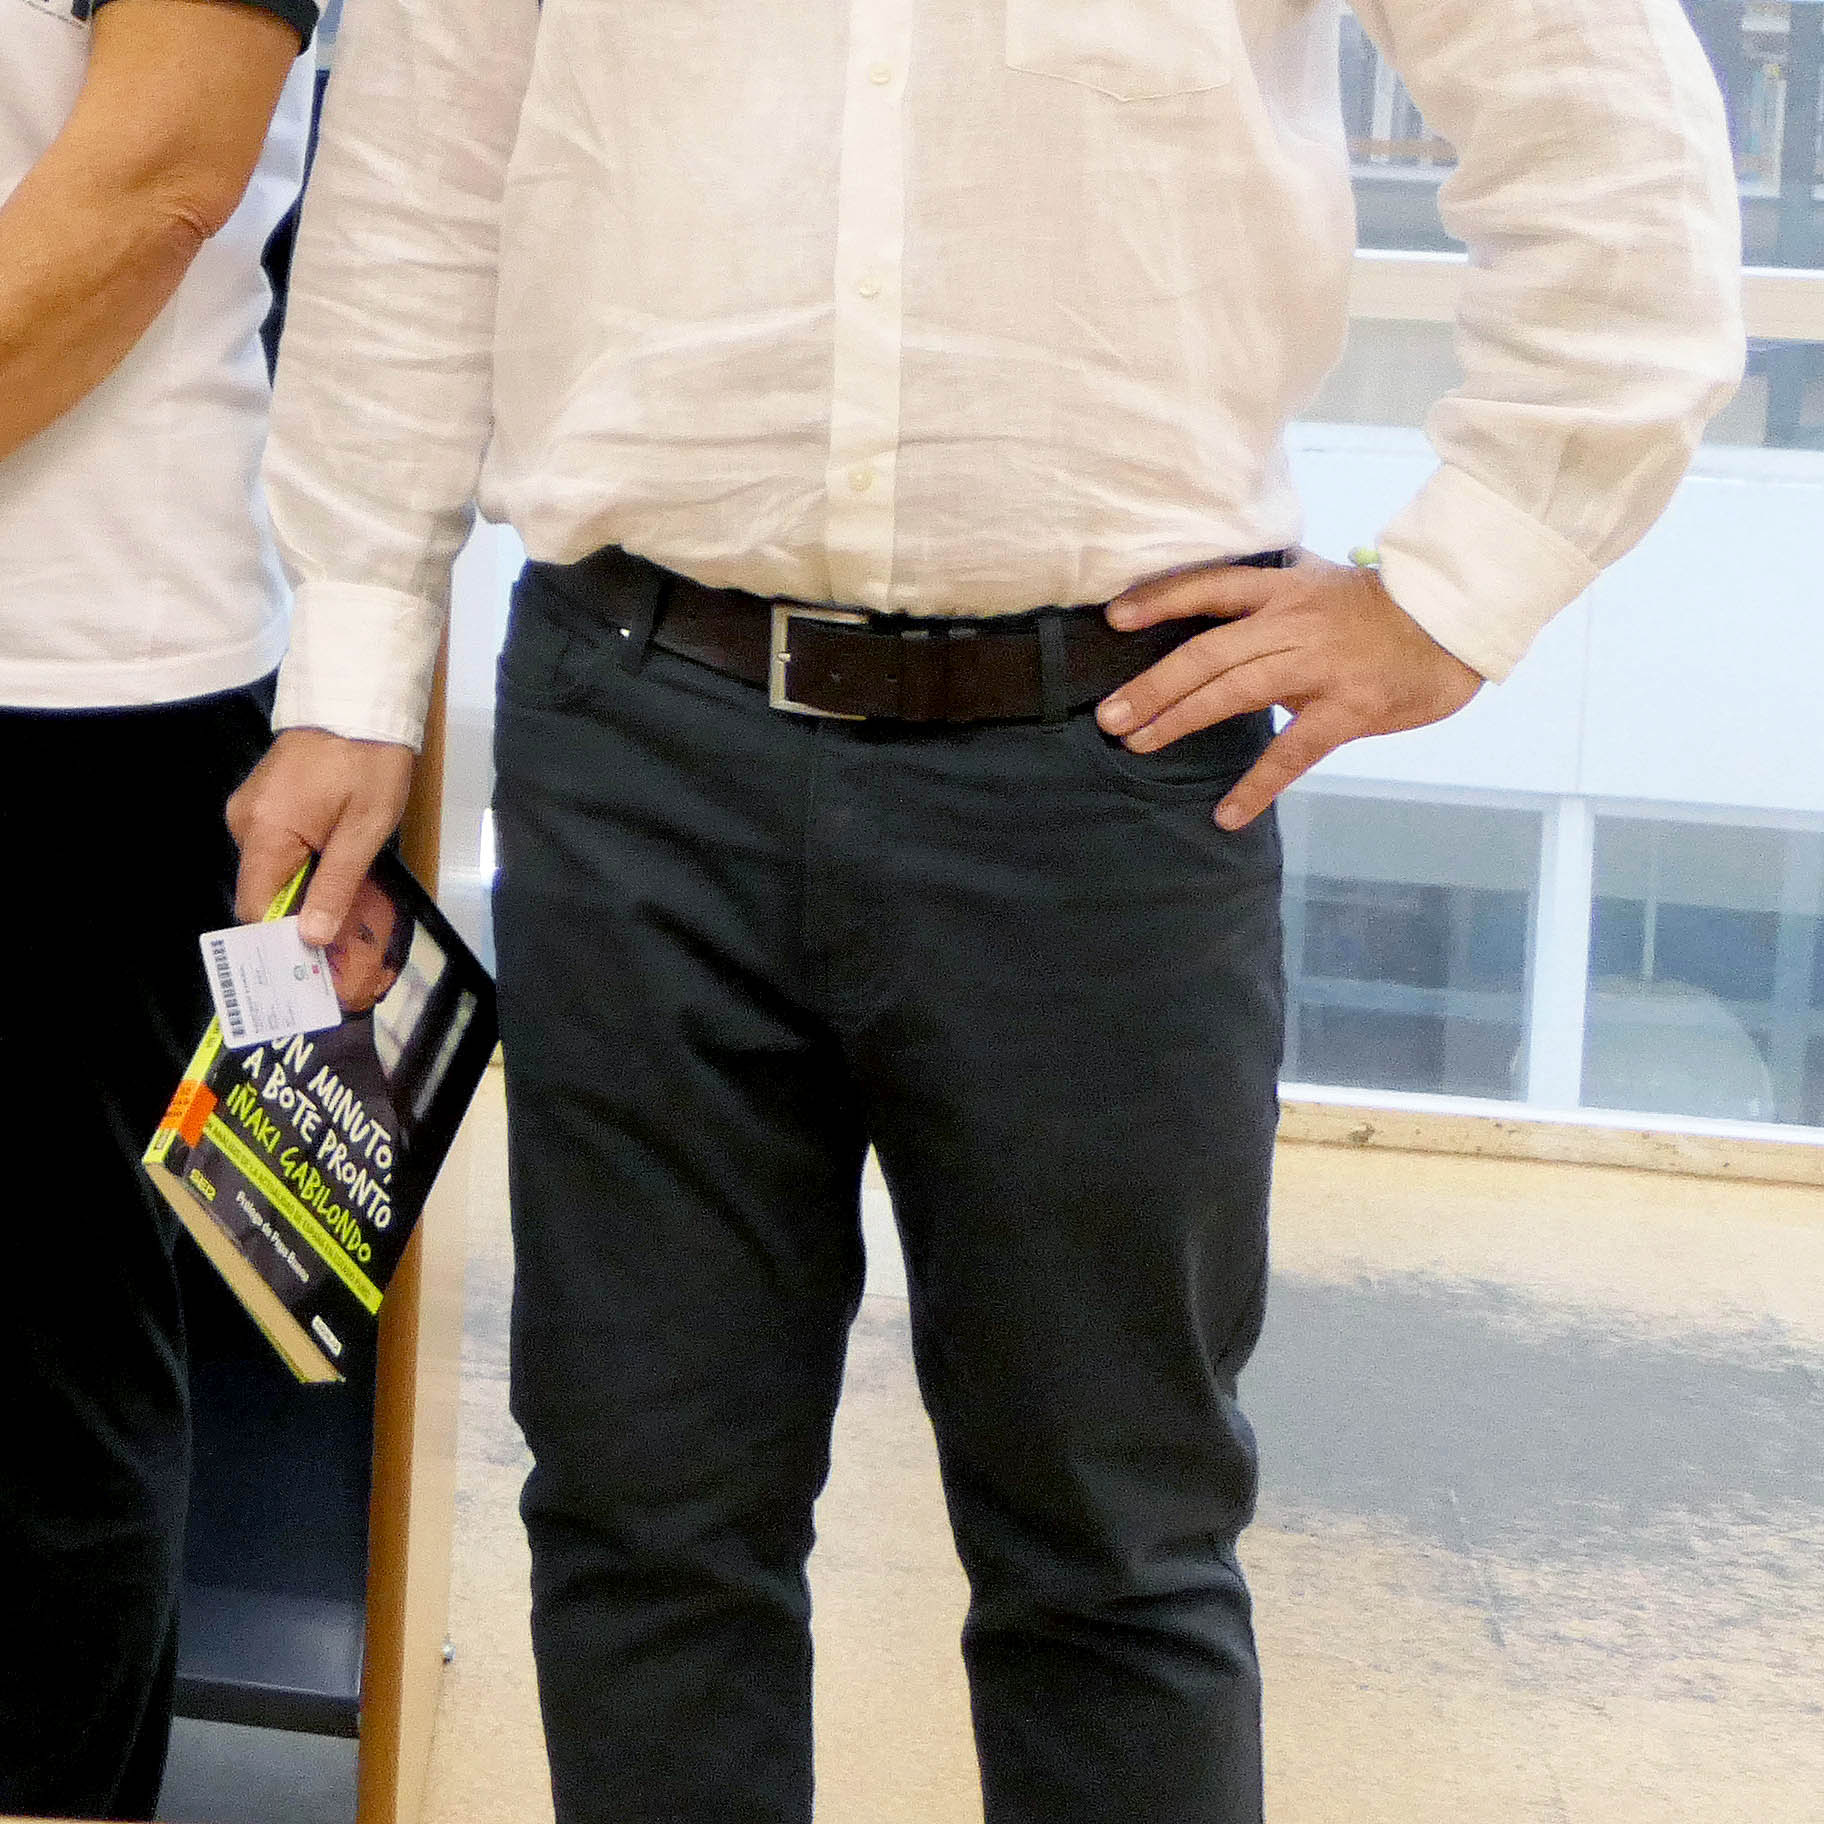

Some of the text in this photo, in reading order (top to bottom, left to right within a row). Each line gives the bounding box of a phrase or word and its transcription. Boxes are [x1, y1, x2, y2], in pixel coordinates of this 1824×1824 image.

[227, 1080, 281, 1153] IÑAKI
[280, 1147, 371, 1262] GABILONDO
[242, 1046, 265, 1079] A
[262, 1063, 323, 1142] BOTE
[317, 1128, 392, 1228] PRONTO
[307, 1065, 393, 1185] MINUTO,
